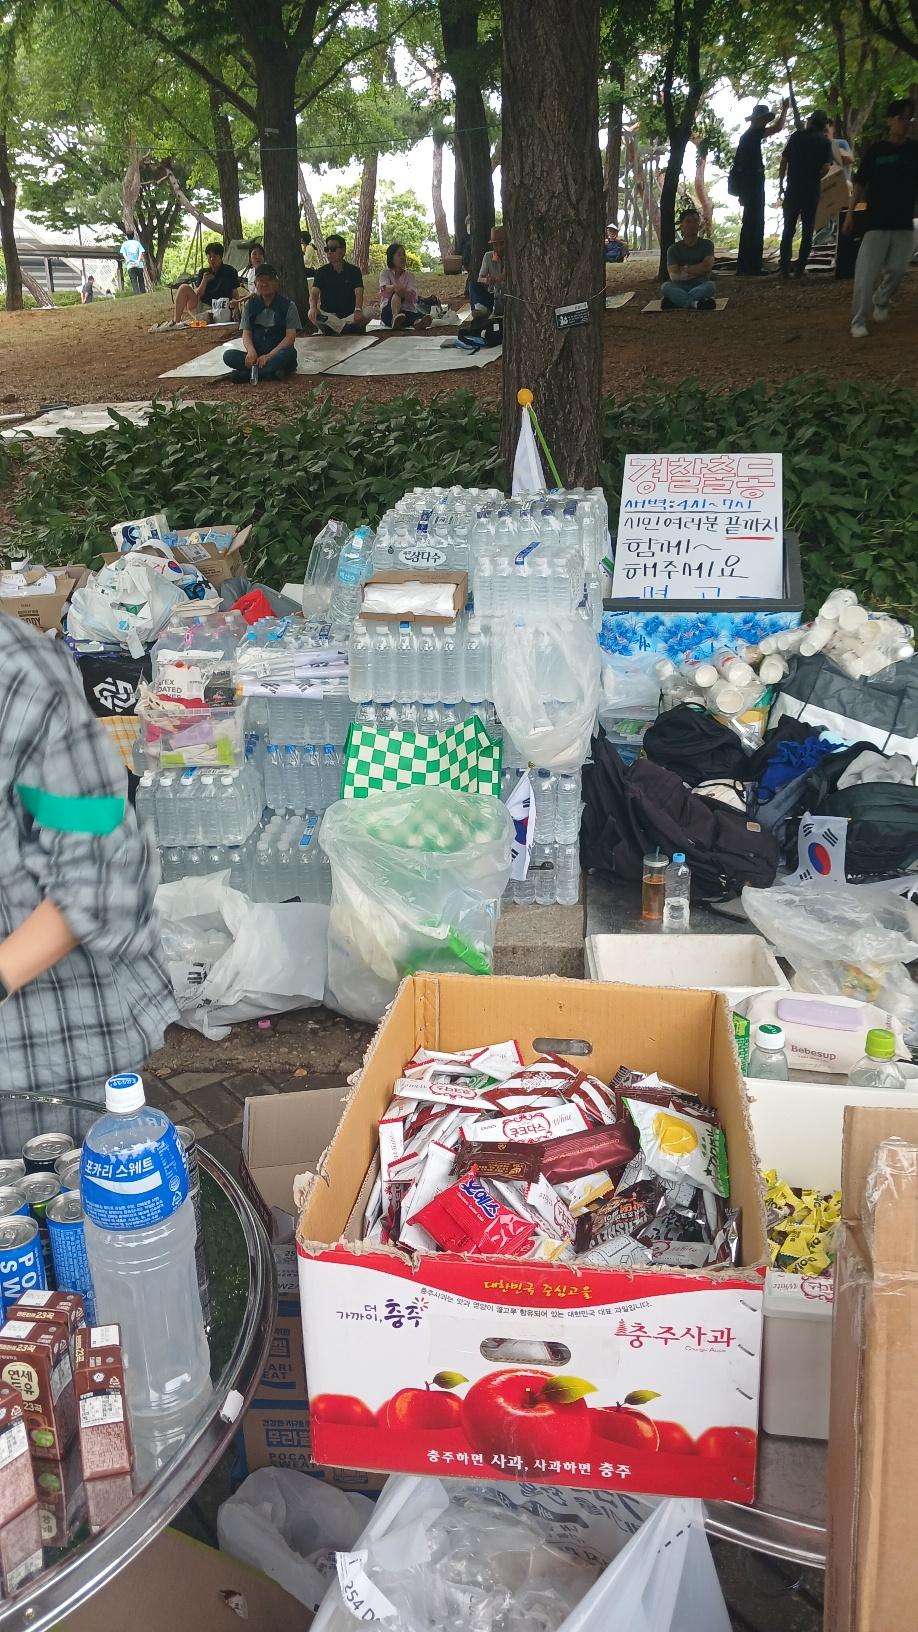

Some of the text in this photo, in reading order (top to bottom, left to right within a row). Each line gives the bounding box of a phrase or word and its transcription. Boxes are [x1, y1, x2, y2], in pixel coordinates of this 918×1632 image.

[628, 455, 775, 499] 경찰출동
[725, 516, 778, 535] 끝까지
[622, 555, 749, 579] 해주세요
[791, 1045, 837, 1060] Bebesup
[510, 1123, 546, 1137] 쿠크다스
[85, 1159, 113, 1178] 포카리
[116, 1157, 154, 1177] 스웨트
[543, 1284, 592, 1299] 중심고을
[336, 1298, 422, 1328] 가까이, 충주
[364, 1304, 377, 1312] 더
[567, 1310, 596, 1318] 대한민국
[620, 1321, 737, 1349] 충주사과
[8, 1369, 32, 1382] 연세
[426, 1449, 633, 1479] 충주하면 사과, 사과하면 충주
